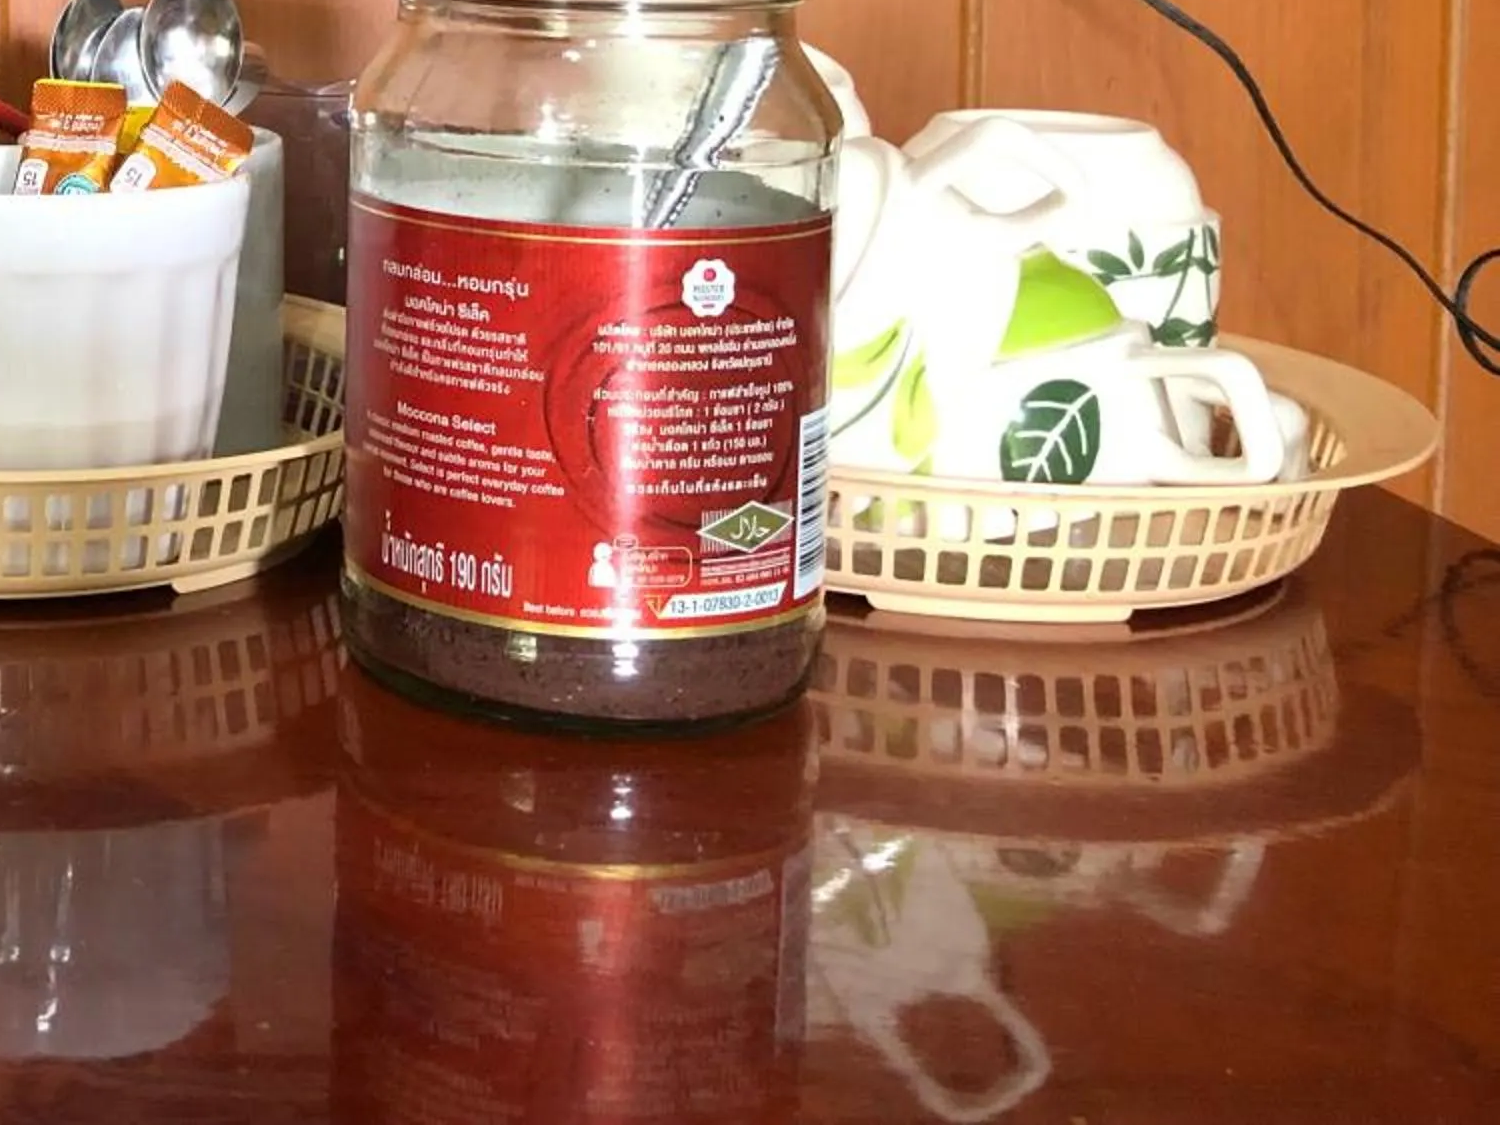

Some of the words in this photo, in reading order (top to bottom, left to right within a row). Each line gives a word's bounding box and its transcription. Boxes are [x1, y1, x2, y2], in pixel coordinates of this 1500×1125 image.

[397, 400, 449, 426] Moccona
[451, 413, 497, 435] Select
[468, 458, 501, 473] aroma
[503, 461, 518, 475] for
[521, 467, 547, 479] your
[433, 483, 447, 496] are
[449, 486, 479, 503] coffee
[446, 470, 480, 486] perfect
[481, 475, 528, 493] everyday
[531, 482, 565, 497] coffee
[729, 515, 770, 540] حلال
[450, 552, 477, 591] 190
[481, 553, 513, 598] กรัม
